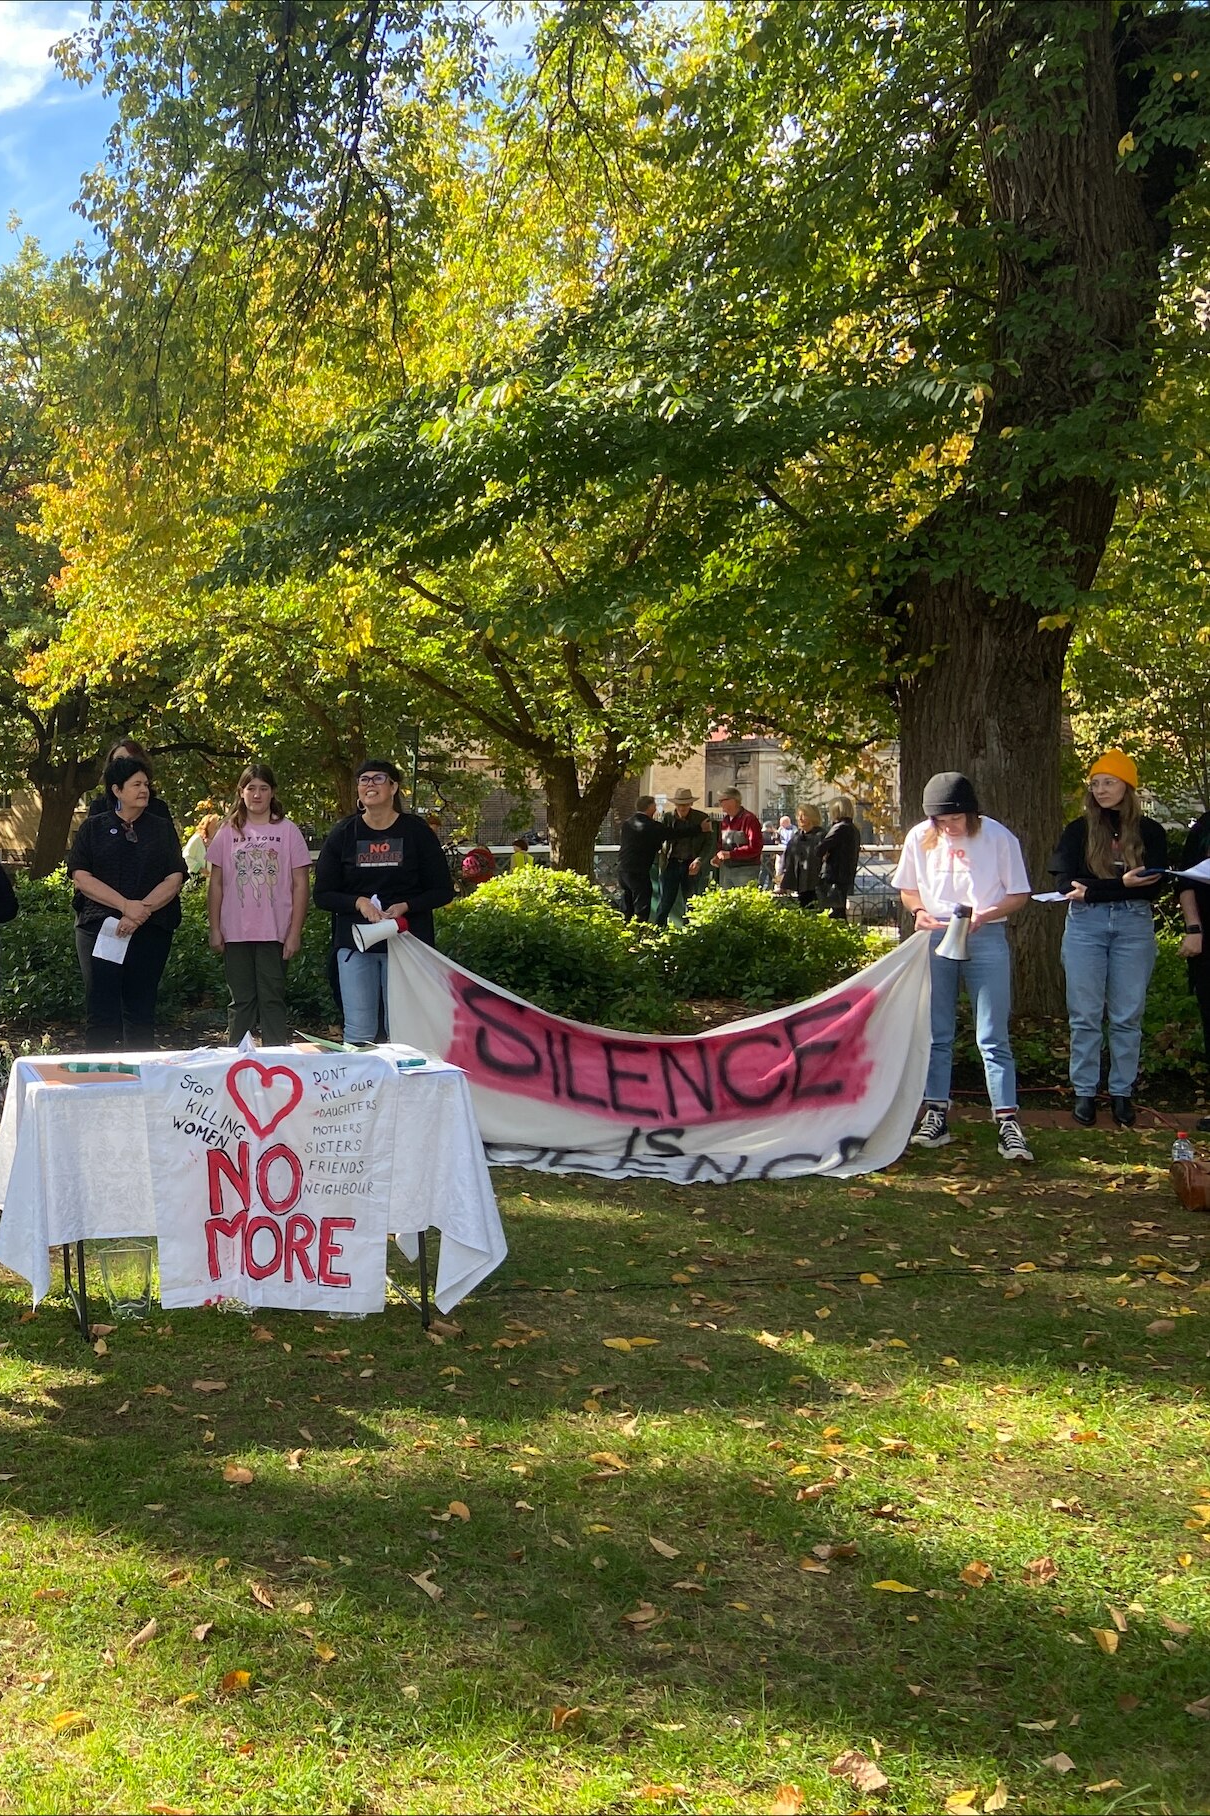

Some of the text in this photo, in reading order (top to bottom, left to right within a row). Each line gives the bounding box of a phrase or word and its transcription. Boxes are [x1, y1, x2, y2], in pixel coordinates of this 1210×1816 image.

[358, 852, 403, 863] MORE
[370, 842, 390, 853] NO
[462, 984, 853, 1120] SILENCE
[180, 1074, 214, 1098] STOP
[320, 1079, 375, 1103] KILL OUR
[185, 1098, 246, 1140] KILLING
[319, 1099, 378, 1118] DAUGHTERS
[173, 1116, 230, 1149] WOMEN
[312, 1123, 363, 1136] MOTHERS
[304, 1139, 363, 1154] SISTERS
[622, 1126, 685, 1158] IS
[206, 1141, 304, 1216] NO
[308, 1160, 366, 1175] FRIENDS
[303, 1181, 375, 1196] NEIGHBOUR
[205, 1209, 357, 1288] MORE
